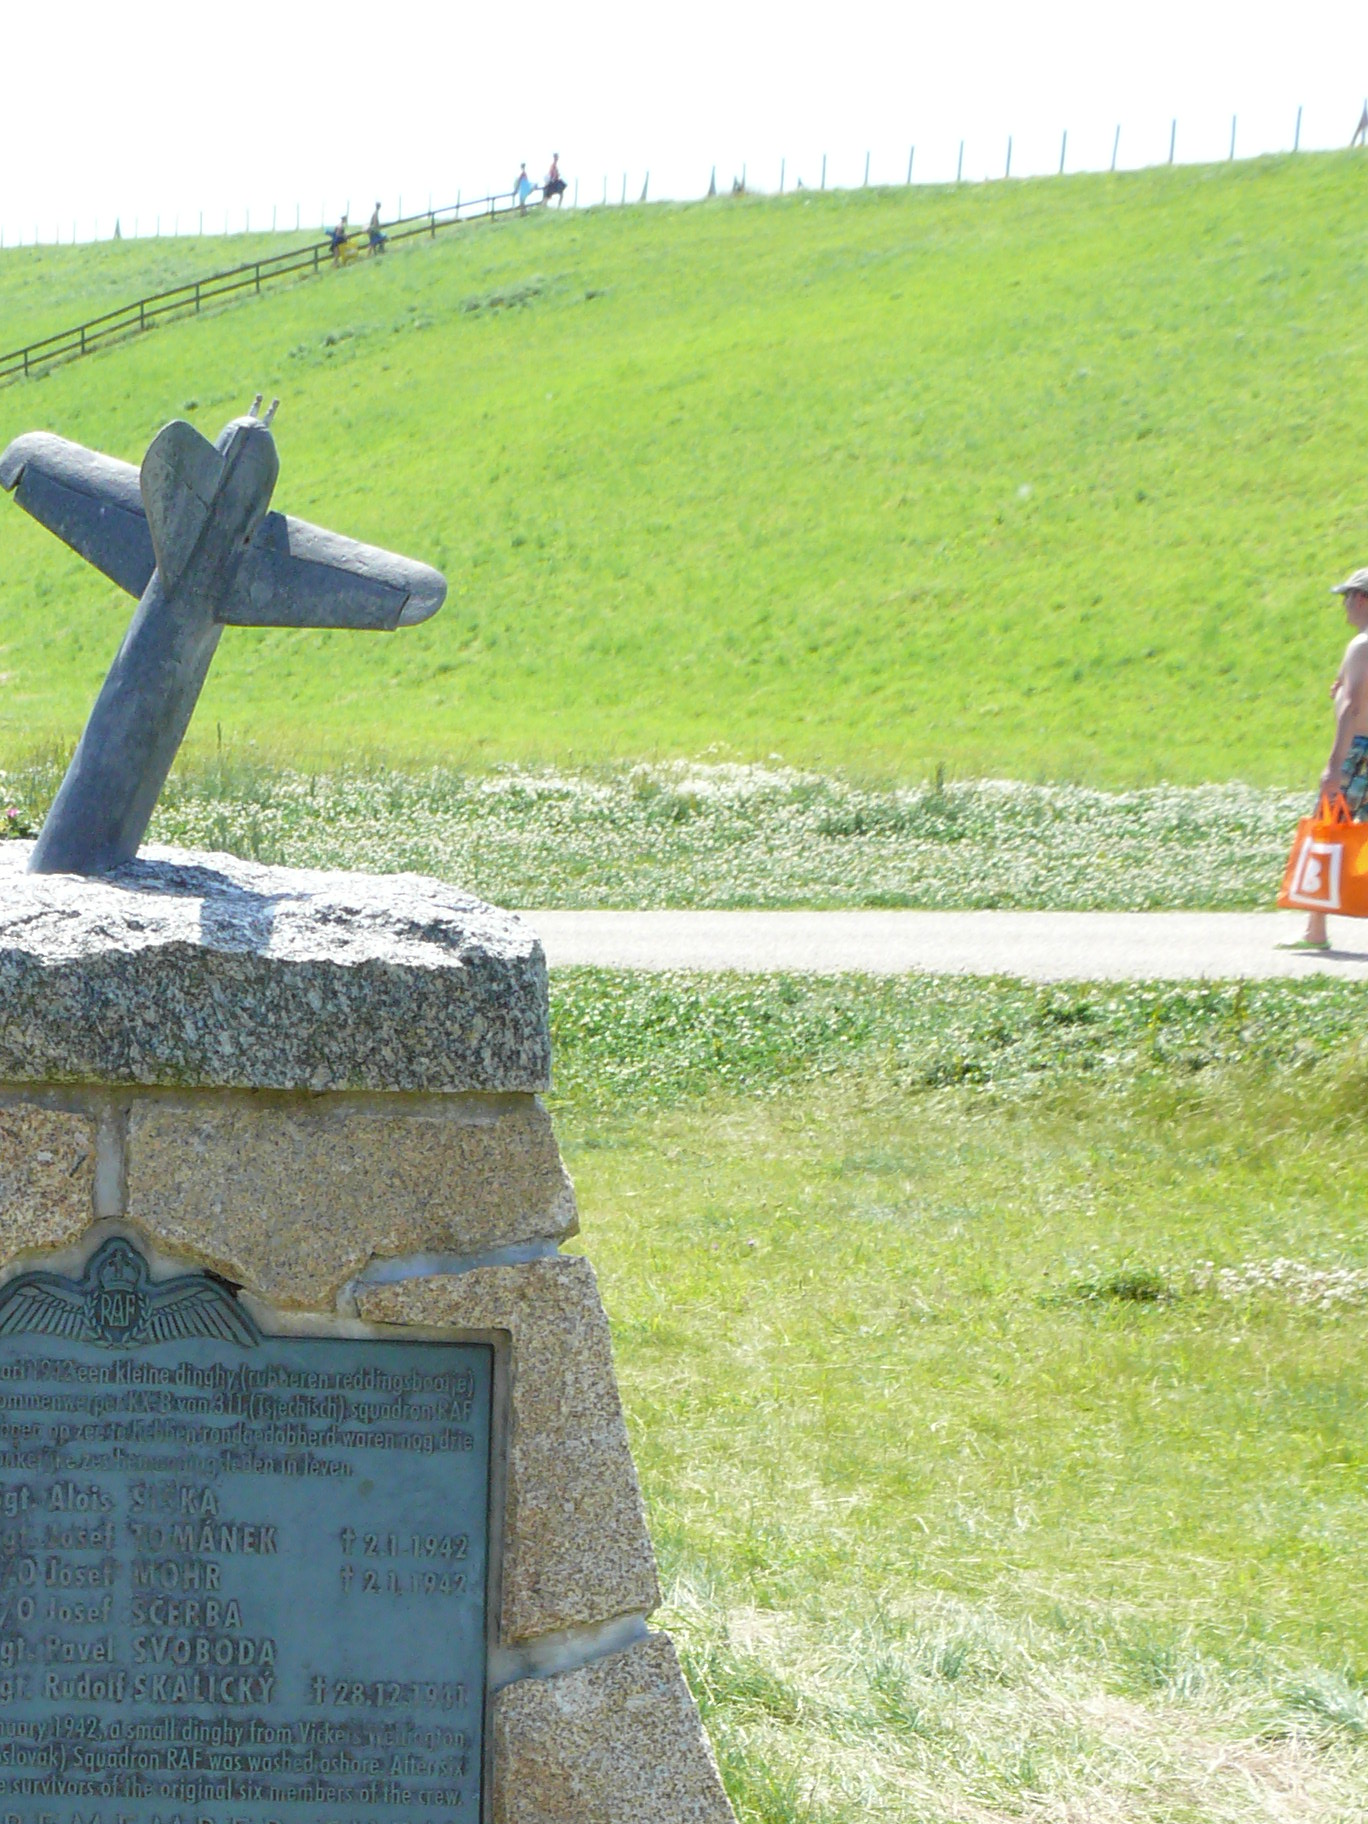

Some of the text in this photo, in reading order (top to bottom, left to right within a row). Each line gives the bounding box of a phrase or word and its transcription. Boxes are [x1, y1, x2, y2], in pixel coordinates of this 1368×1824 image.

[101, 1293, 136, 1327] RAF
[78, 1367, 110, 1383] een
[116, 1361, 169, 1384] kleine
[175, 1362, 236, 1390] dinghy
[176, 1399, 208, 1415] van
[214, 1394, 243, 1416] 311
[250, 1395, 346, 1422] (Tsjechisch)
[351, 1399, 433, 1424] squadron
[438, 1401, 473, 1422] RAF
[50, 1424, 70, 1445] op
[202, 1422, 338, 1447] rondgedobberd
[343, 1431, 395, 1449] waren
[401, 1431, 433, 1455] nog
[440, 1428, 474, 1450] drie
[282, 1453, 299, 1475] in
[51, 1483, 114, 1512] Alois
[46, 1558, 115, 1587] Josef
[133, 1561, 221, 1591] MOHR
[48, 1597, 113, 1623] Josef
[47, 1635, 114, 1663] Pavel
[133, 1636, 277, 1666] SVOBODA
[45, 1671, 126, 1703] Rudolf
[133, 1671, 275, 1704] SKALICKÝ
[110, 1722, 122, 1739] a
[128, 1717, 176, 1742] small
[182, 1718, 243, 1747] dinghy
[250, 1720, 293, 1744] from
[299, 1722, 362, 1746] Vickers
[73, 1746, 160, 1770] Squadron
[167, 1748, 204, 1769] RAF
[208, 1755, 242, 1772] was
[248, 1750, 314, 1774] washed
[11, 1776, 95, 1795] survivors
[101, 1774, 118, 1795] of
[126, 1775, 152, 1797] the
[160, 1777, 233, 1803] original
[239, 1779, 264, 1801] six
[270, 1781, 353, 1802] members
[359, 1783, 377, 1803] of
[384, 1782, 412, 1804] the
